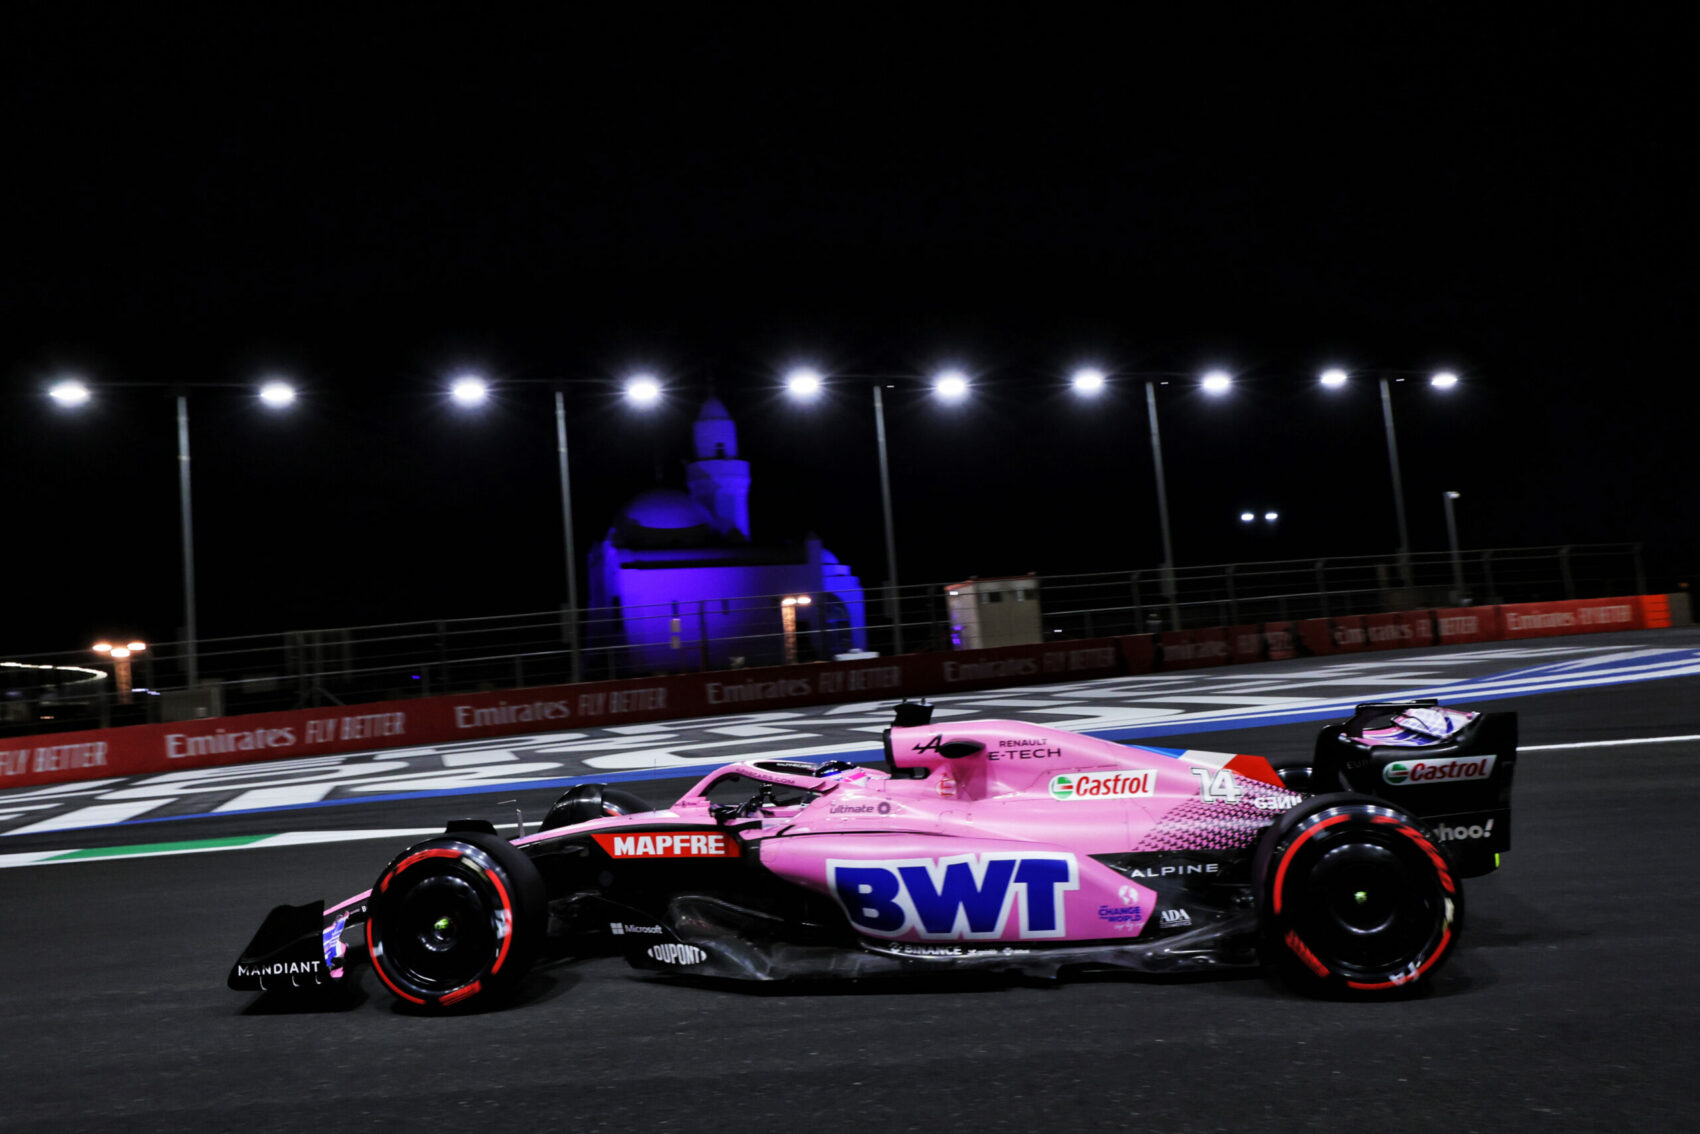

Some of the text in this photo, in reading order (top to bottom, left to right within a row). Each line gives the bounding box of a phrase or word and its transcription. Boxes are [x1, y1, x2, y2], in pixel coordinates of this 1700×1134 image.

[705, 665, 901, 705] Emirates FLY BETTER
[453, 687, 669, 729] Emirates FLY BETTER
[163, 711, 407, 760] Emirates FLY BETTER
[999, 738, 1047, 748] RENAULT
[32, 741, 108, 773] BETTER
[988, 747, 1062, 761] E-TECH
[1410, 758, 1487, 781] Castrol
[1075, 772, 1150, 797] Castrol
[1190, 767, 1243, 805] 14
[829, 803, 875, 814] ultimate
[613, 834, 727, 857] MAPFRE
[1130, 863, 1220, 878] ALPINE
[830, 854, 1077, 938] BWT
[1098, 906, 1141, 916] CHANGE
[1161, 908, 1191, 922] ADA
[624, 924, 663, 935] Microsoft
[653, 943, 702, 966] DUPONT
[237, 960, 321, 977] MANDIANT
